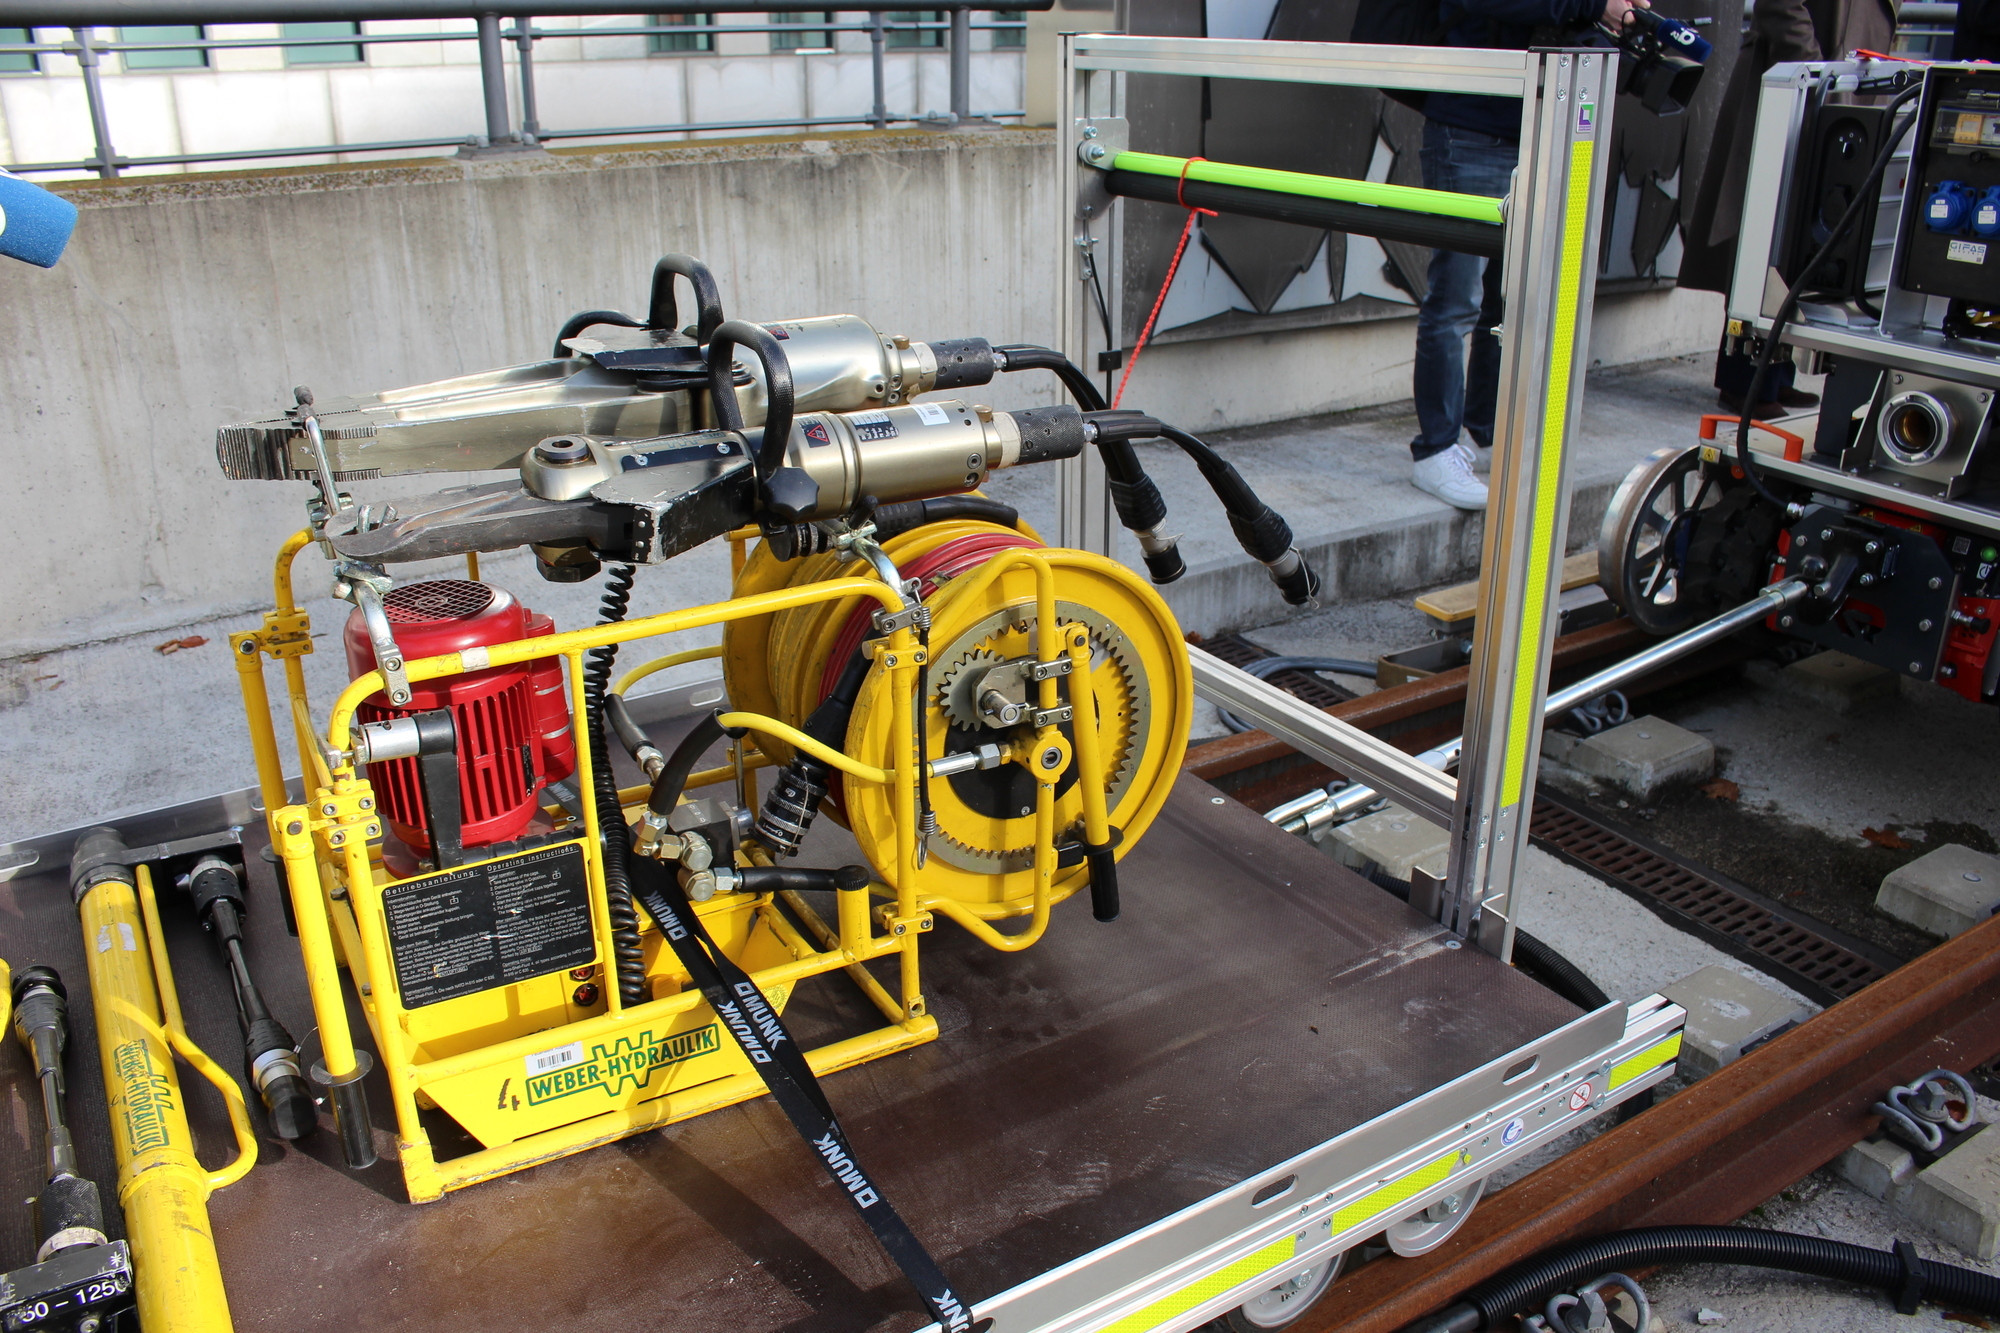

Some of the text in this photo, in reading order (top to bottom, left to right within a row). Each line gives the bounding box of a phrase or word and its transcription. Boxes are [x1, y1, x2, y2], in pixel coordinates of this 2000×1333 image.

[1950, 242, 1986, 253] GIFAS
[487, 845, 576, 872] Operating instructions:
[385, 869, 478, 896] Betriebsanleitung:
[643, 890, 681, 929] MUNK
[718, 1000, 761, 1050] MUNK
[742, 995, 787, 1050] MUNK
[531, 1029, 713, 1099] WEBER-HYDRAULIK
[813, 1132, 867, 1194] MUNK
